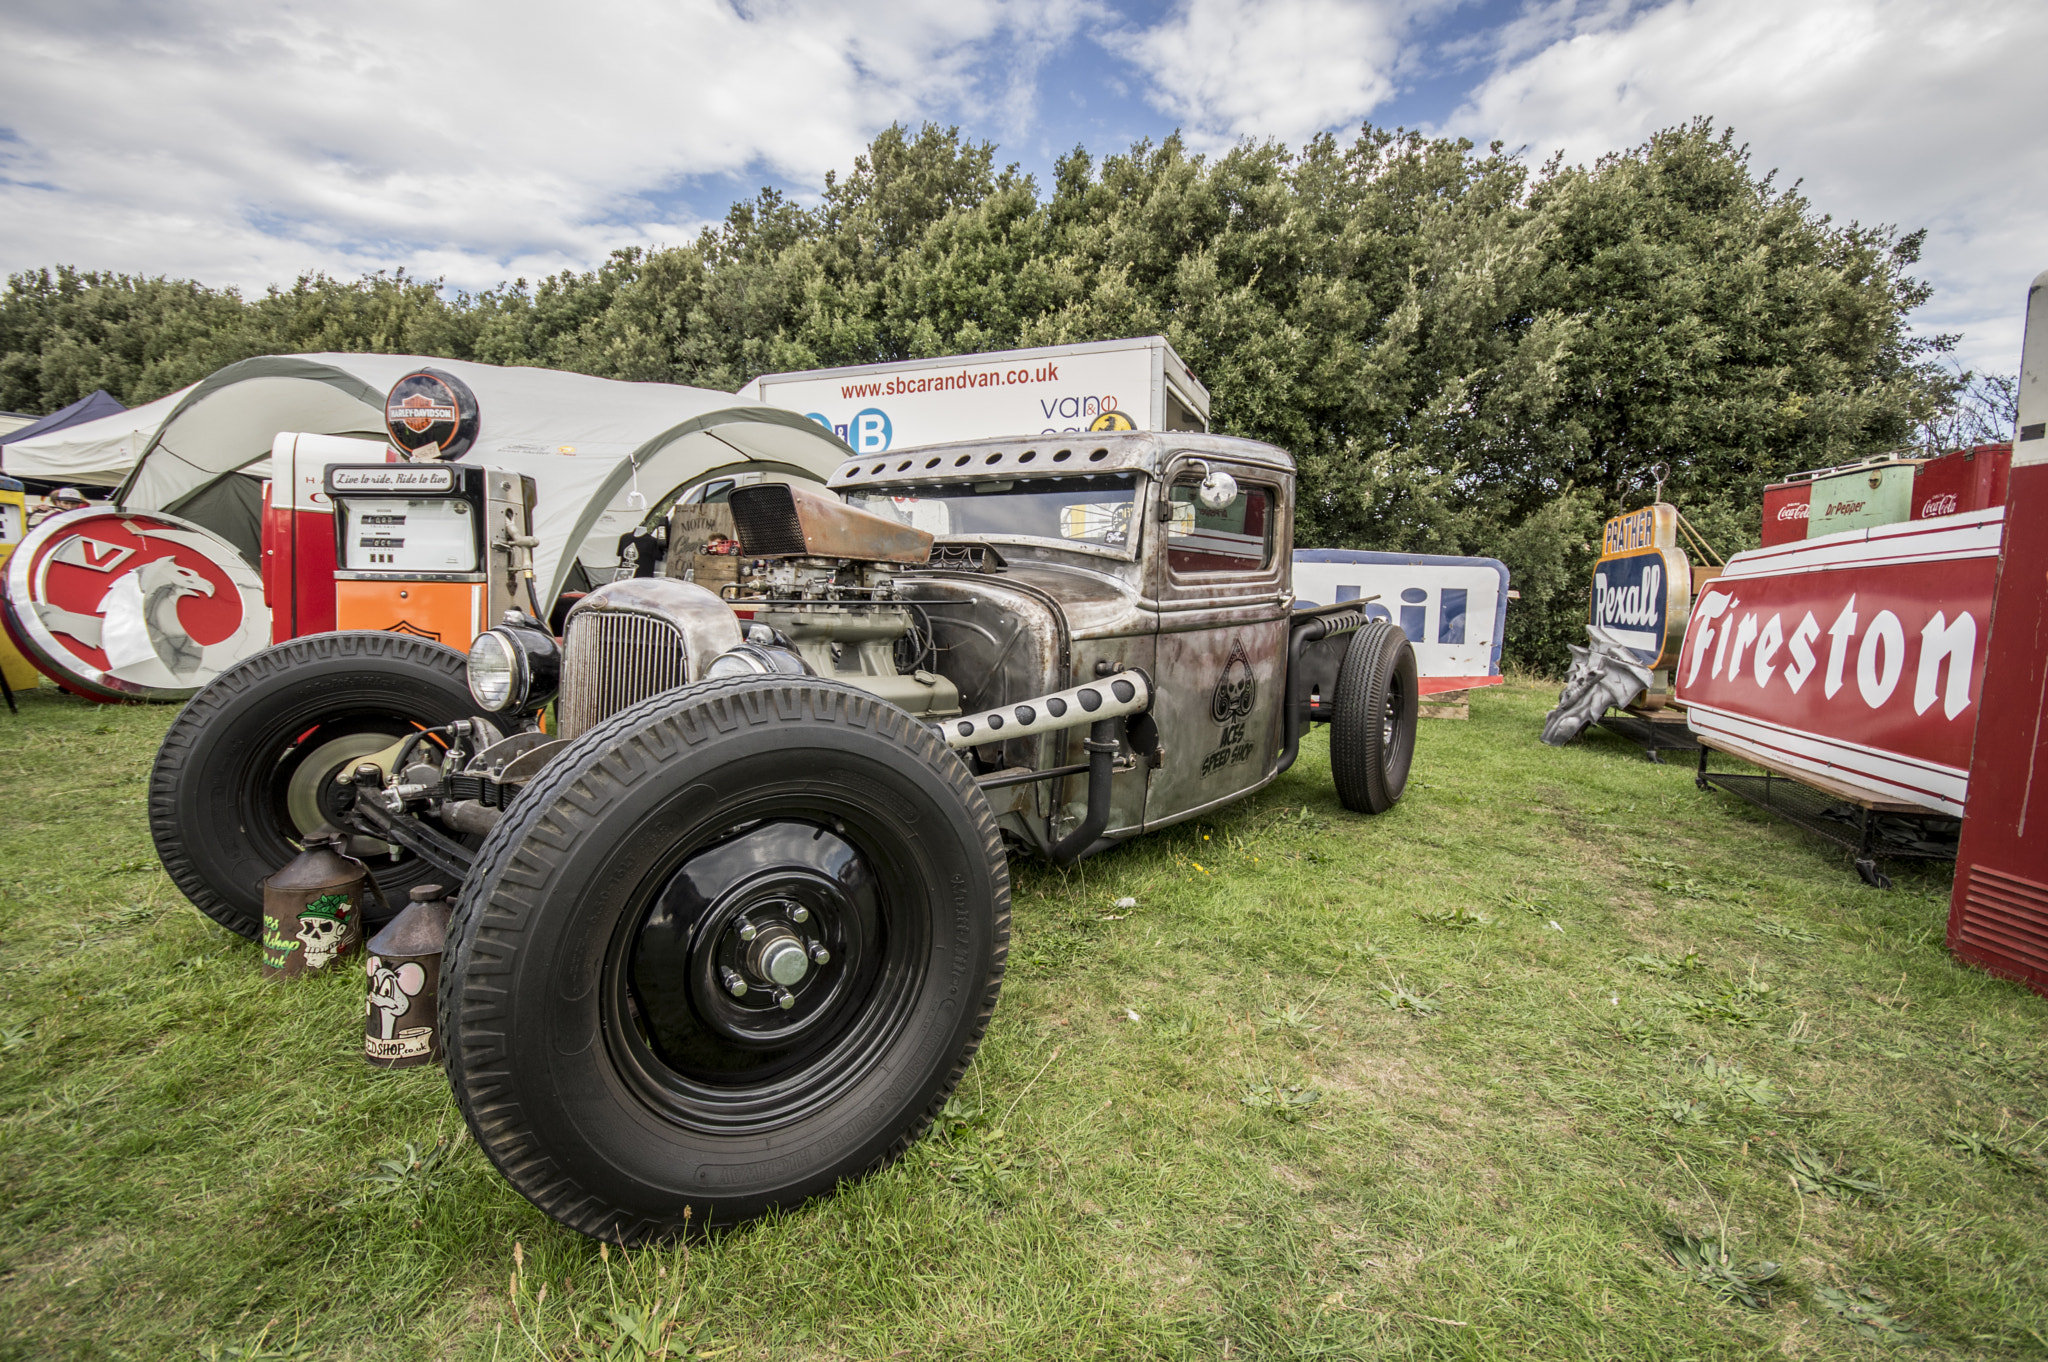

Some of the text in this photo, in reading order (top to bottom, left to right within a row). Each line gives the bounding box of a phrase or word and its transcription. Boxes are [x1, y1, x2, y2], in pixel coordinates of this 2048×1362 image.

[841, 362, 1059, 399] www.sbcarandvan.co.uk
[390, 408, 452, 418] HARLEY-DAVIDSON
[336, 473, 359, 484] Live
[360, 473, 371, 484] to
[395, 473, 417, 484] Ride
[419, 473, 429, 484] to
[430, 472, 448, 484] live
[1605, 510, 1653, 555] PRATHER
[1595, 564, 1660, 630] Rexall
[1684, 590, 1978, 722] Fireston
[1219, 722, 1246, 749] ACES
[1201, 743, 1255, 777] SPEED SHOP
[819, 1103, 881, 1157] SUPER
[719, 1149, 812, 1184] HIGHWAY
